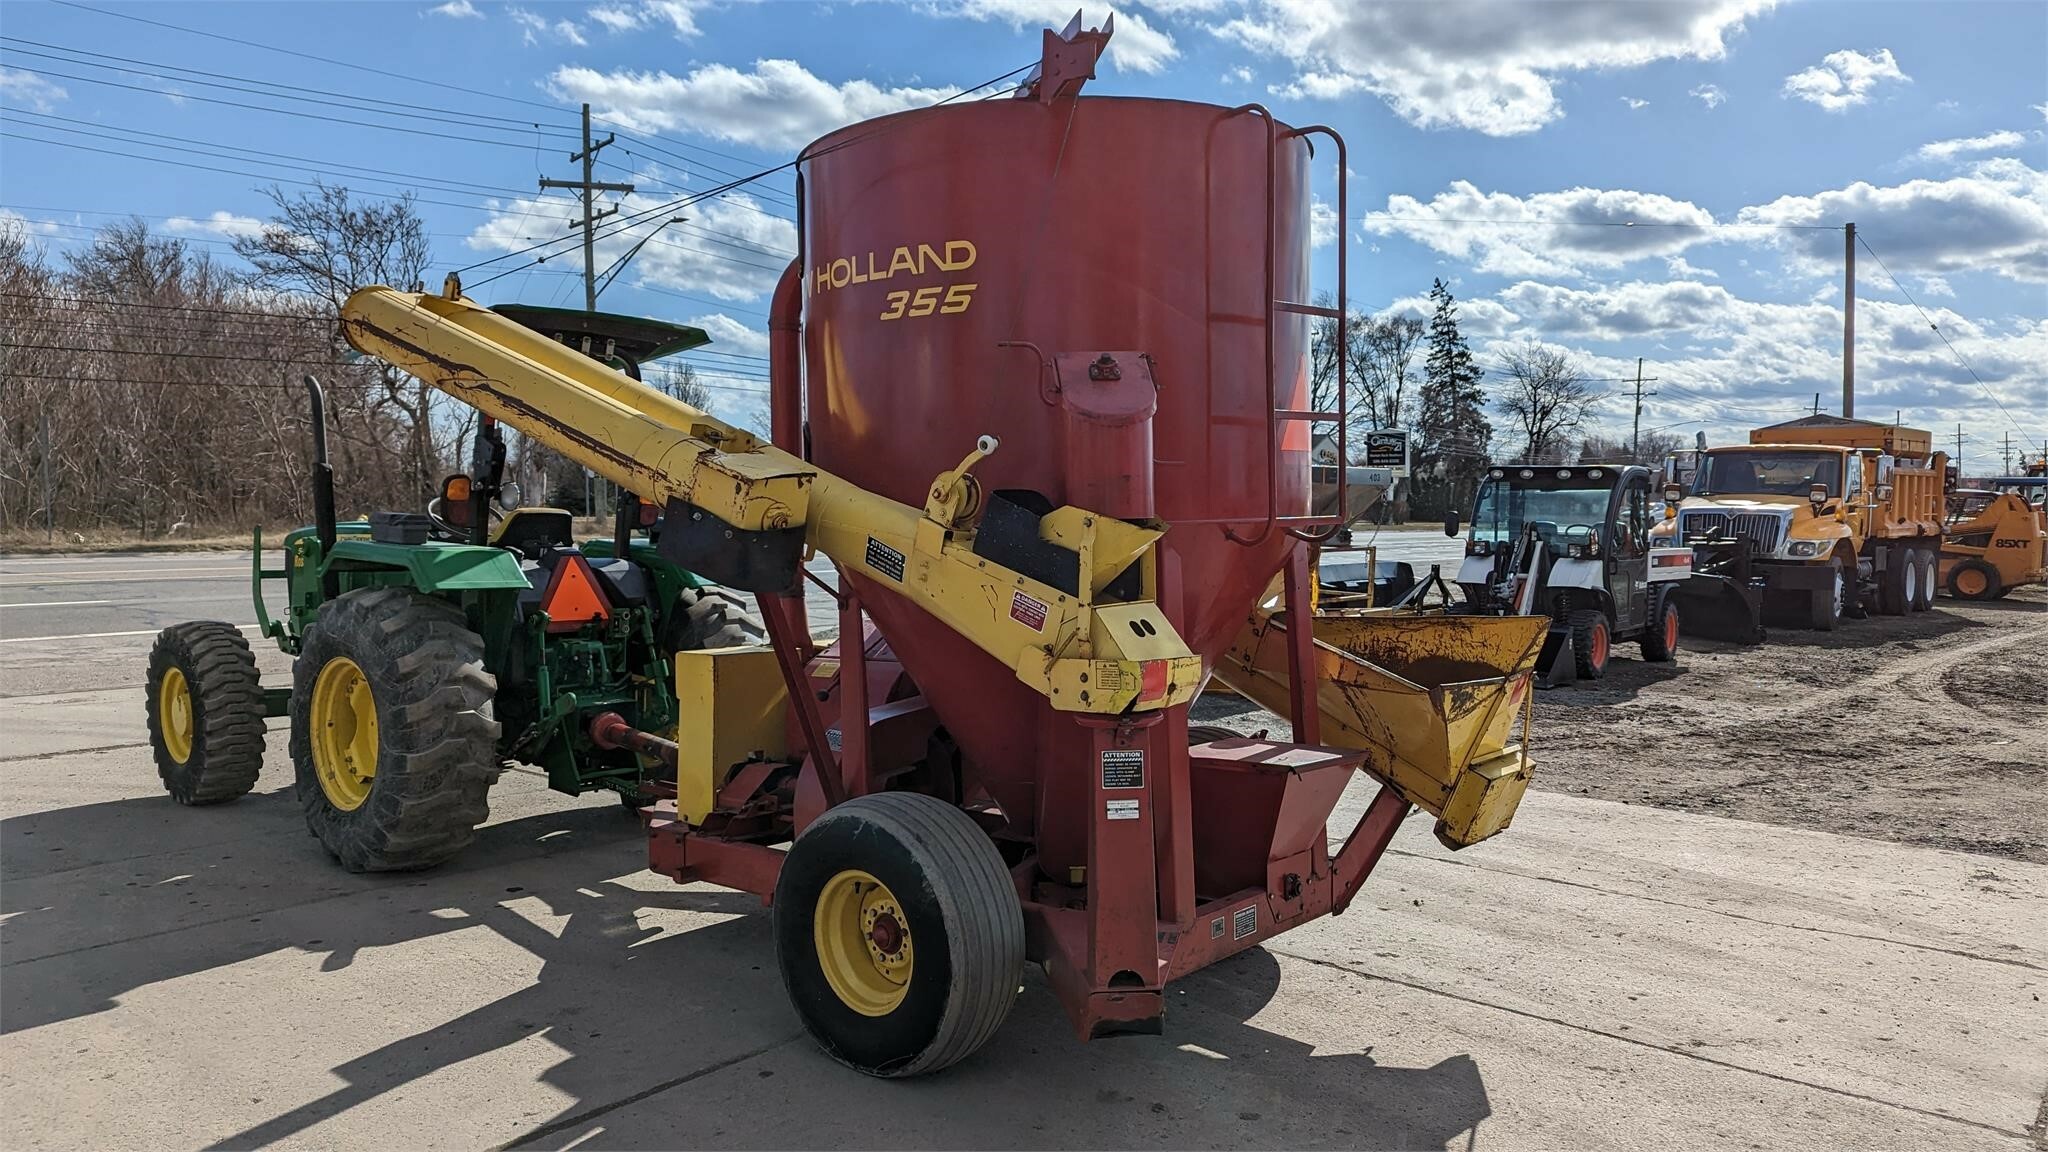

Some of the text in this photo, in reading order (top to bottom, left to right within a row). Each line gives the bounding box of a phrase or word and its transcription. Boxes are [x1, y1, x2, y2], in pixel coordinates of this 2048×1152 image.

[816, 240, 977, 294] HOLLAND
[880, 284, 977, 320] 355
[870, 540, 903, 561] ATTENTION
[1995, 539, 2031, 549] 85XT
[1021, 595, 1042, 609] DANGER
